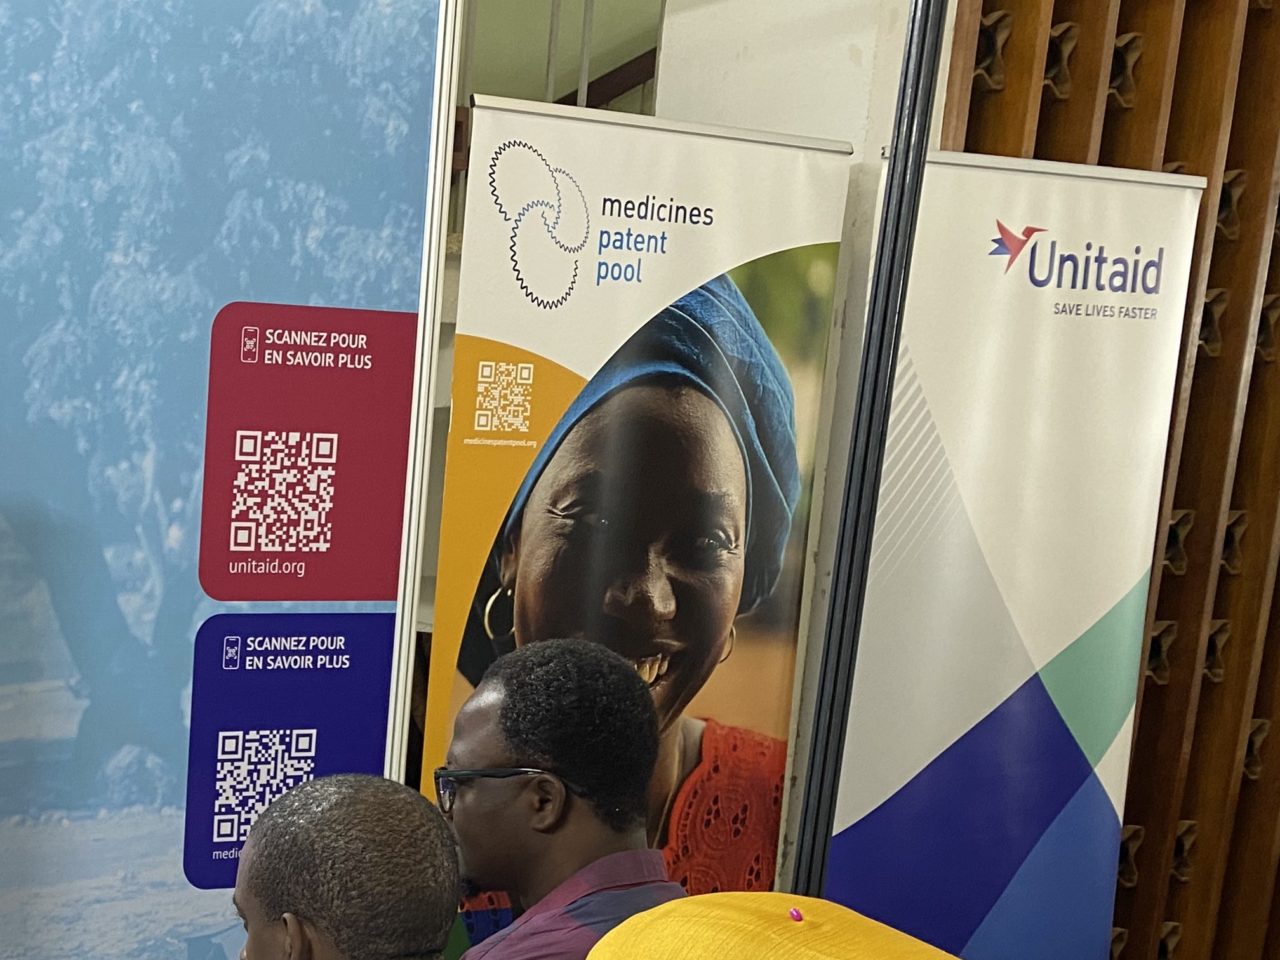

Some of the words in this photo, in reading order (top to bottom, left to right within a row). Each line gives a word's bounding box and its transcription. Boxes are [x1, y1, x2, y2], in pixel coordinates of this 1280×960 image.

[602, 195, 715, 226] medicines
[598, 227, 668, 255] patent
[596, 258, 643, 286] pool
[1028, 240, 1165, 295] Unitaid
[1053, 302, 1082, 316] SAVE
[1085, 304, 1116, 318] LIVES
[1119, 306, 1158, 320] FASTER
[265, 329, 327, 347] SCANNEZ
[330, 333, 368, 349] POUR
[264, 350, 282, 365] EN
[286, 351, 335, 368] SAVOIR
[338, 354, 373, 369] PLUS
[228, 559, 306, 577] unitaid.org
[246, 636, 306, 651] SCANNEZ
[309, 636, 346, 650] POUR
[245, 656, 263, 669] EN
[266, 655, 313, 669] SAVOIR
[316, 655, 350, 669] PLUS
